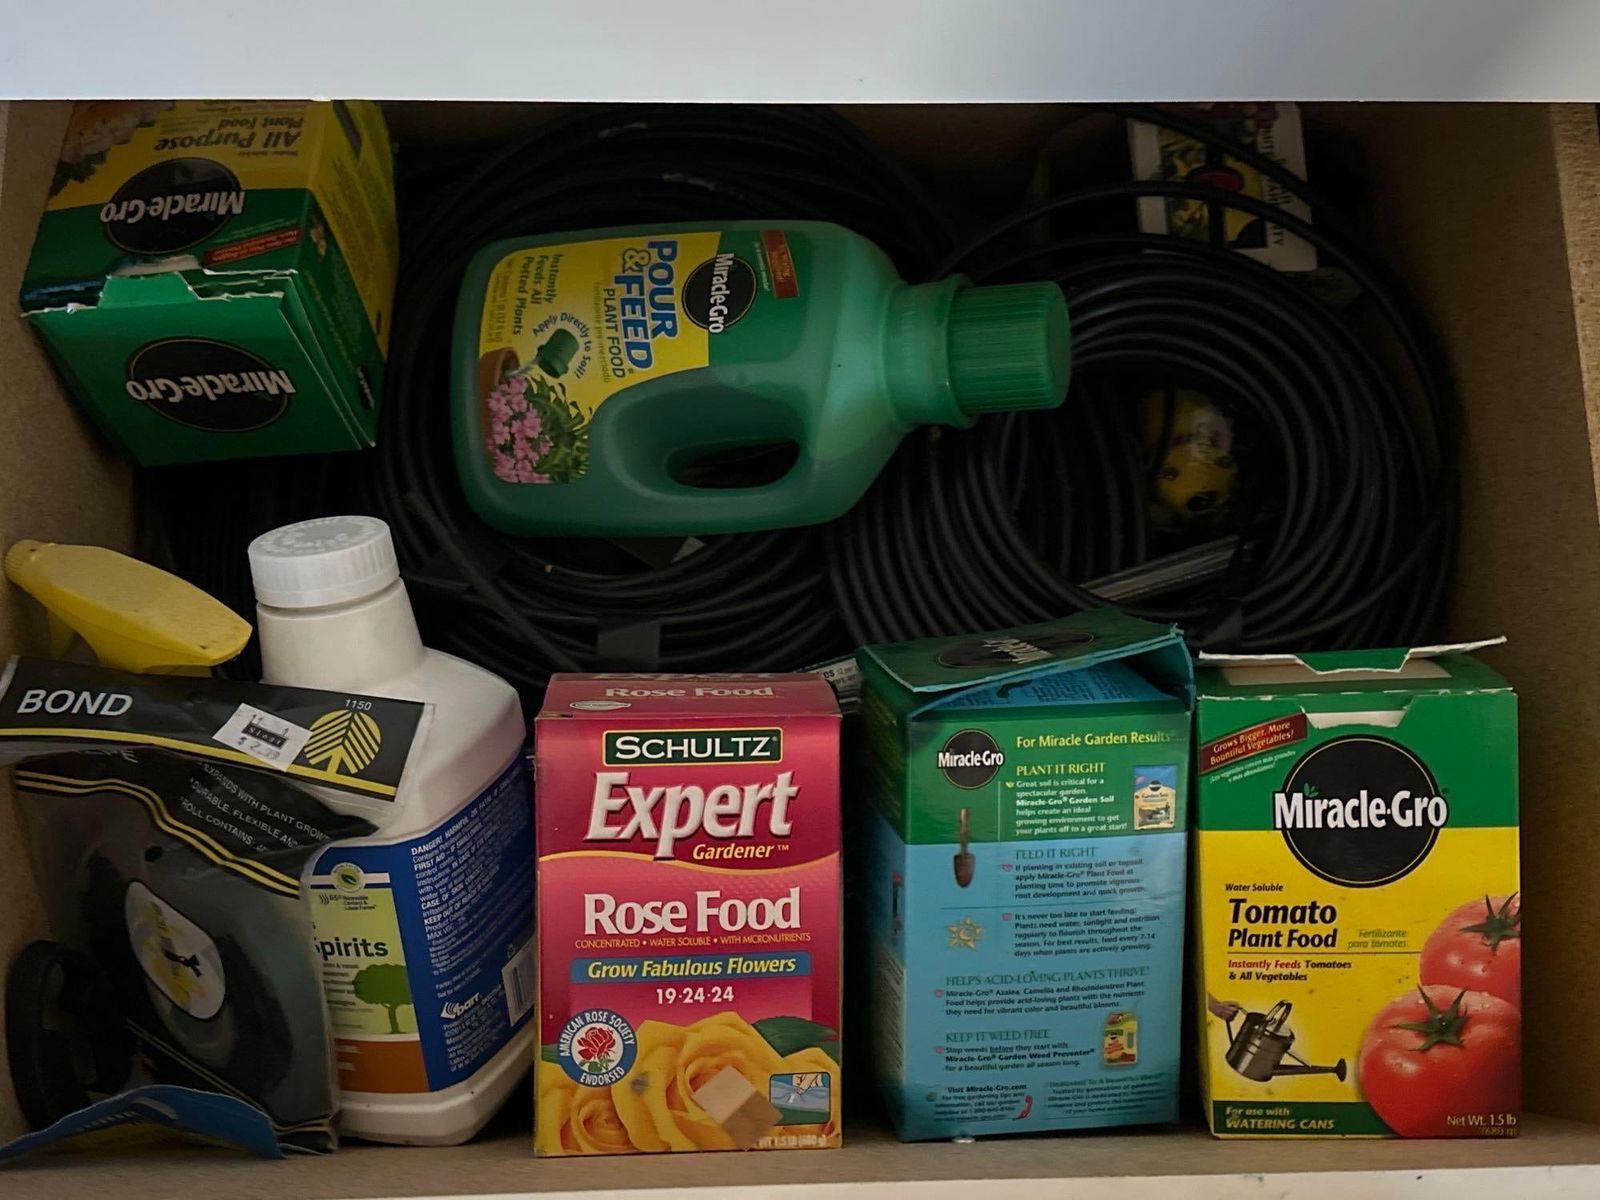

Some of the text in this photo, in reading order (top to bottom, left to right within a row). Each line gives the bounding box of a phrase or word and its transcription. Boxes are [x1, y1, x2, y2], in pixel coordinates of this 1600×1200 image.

[218, 117, 303, 130] Plant Food
[154, 129, 301, 150] All Purpose
[100, 192, 245, 224] Miracle-Gro
[530, 255, 549, 304] Feeds All
[543, 254, 563, 304] Instantly
[514, 257, 533, 335] Potted Plants
[648, 241, 678, 338] POUR
[709, 253, 734, 333] Miracle-Gro
[615, 248, 653, 369] & FEED
[603, 288, 625, 378] PLANT FOOD
[533, 313, 591, 379] Apply Directly to Soil!
[126, 370, 296, 403] Miracle-Gro
[606, 687, 775, 697] Rose Food
[17, 689, 134, 717] BOND
[345, 699, 373, 711] 1150
[616, 736, 771, 759] SCHULTZ
[1016, 736, 1035, 749] For
[1039, 734, 1081, 747] Miracle
[1084, 733, 1127, 745] Garden
[1210, 730, 1294, 765] Bountiful Vegetables!
[1213, 738, 1238, 753] Grows
[1268, 722, 1290, 733] More
[938, 750, 1004, 768] Miracle-Gro
[1017, 763, 1105, 776] PLANT IT RIGHT
[1016, 790, 1058, 798] spectacular
[238, 790, 259, 808] WITH
[260, 804, 295, 826] PLANT
[583, 771, 801, 861] Expert
[1274, 789, 1448, 829] Miracle-Gro
[233, 809, 280, 838] FLEXIBLE
[1016, 818, 1047, 826] growing
[1049, 816, 1096, 824] environment
[1107, 815, 1119, 823] get
[1035, 826, 1057, 835] plants
[1087, 825, 1106, 833] great
[411, 835, 443, 855] DANGER!
[1047, 849, 1055, 858] IT
[1060, 847, 1096, 857] RIGHT
[414, 860, 434, 871] FIRST
[1225, 883, 1283, 892] Water Soluble
[424, 914, 442, 925] KEEP
[584, 887, 801, 935] Rose Food
[1228, 898, 1337, 924] Tomato
[575, 933, 811, 949] CONCENTRATED WATER SOLUBLE WITH MICRONUTRIENTS
[1228, 929, 1338, 947] Plant Food
[1348, 939, 1407, 949] para tomates
[1359, 929, 1408, 939] Fertilizante
[315, 937, 388, 961] pirits
[588, 957, 796, 979] Grow Fabulous Flowers
[1228, 960, 1352, 971] Instantly Feeds Tomatoes
[946, 976, 982, 986] HELPS
[1063, 968, 1105, 982] PLANTS
[1228, 971, 1308, 982] & All Vegetables
[455, 992, 479, 1016] barr
[559, 1011, 636, 1057] AMERICAN ROSE SOCIETY
[946, 1029, 1050, 1042] KEEP IT WEED FREE
[1029, 1051, 1051, 1059] Weed
[580, 1066, 625, 1086] ENDORSED
[1226, 1107, 1290, 1116] For use with
[1447, 1115, 1465, 1126] Net
[1506, 1114, 1516, 1125] lb
[1226, 1118, 1335, 1129] WATERING CANS
